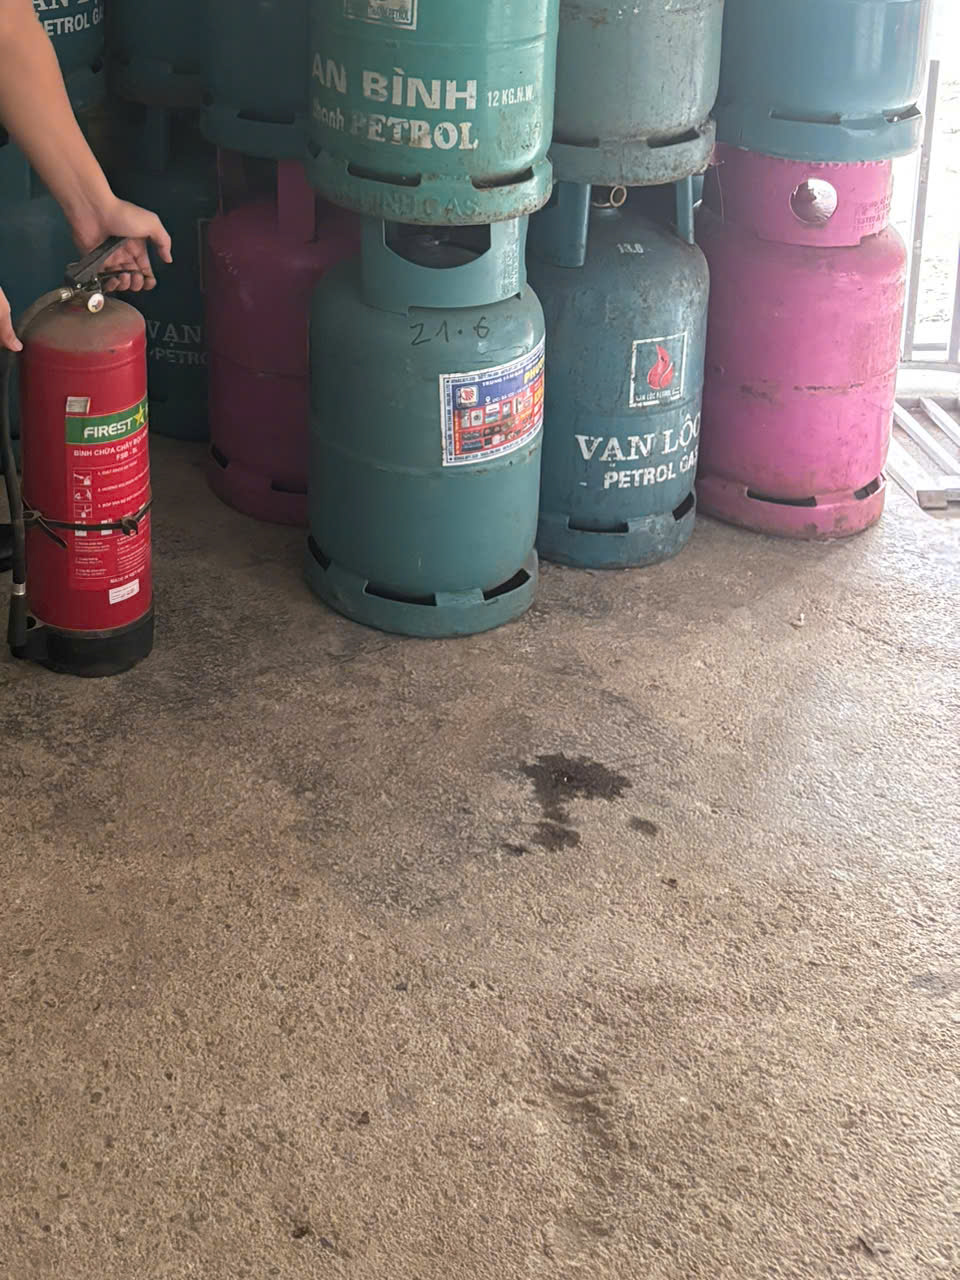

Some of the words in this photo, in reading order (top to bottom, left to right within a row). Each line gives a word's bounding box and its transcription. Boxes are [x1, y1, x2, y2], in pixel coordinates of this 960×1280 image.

[43, 12, 90, 36] ETROL
[363, 67, 477, 110] BÌNH
[488, 90, 499, 107] 12
[350, 111, 479, 150] PETROL
[154, 347, 208, 366] PETRO
[603, 462, 676, 489] PETROL
